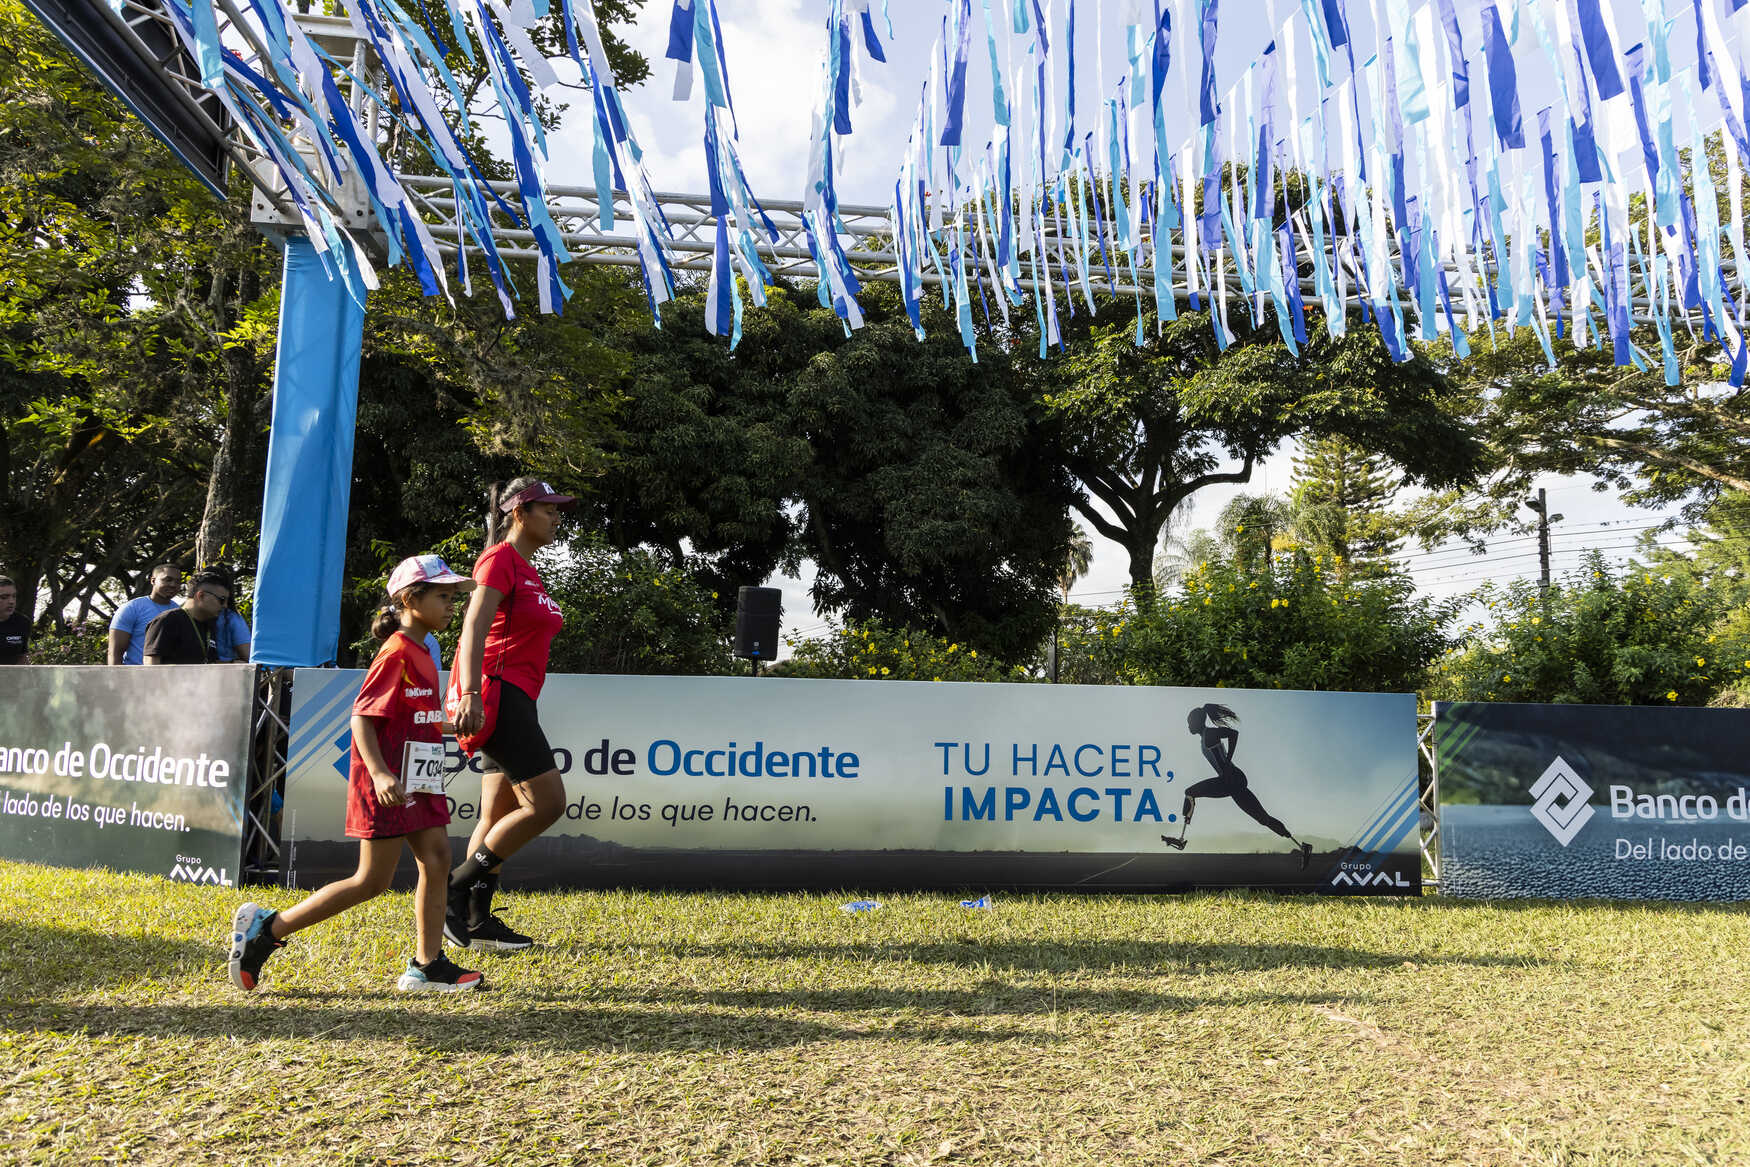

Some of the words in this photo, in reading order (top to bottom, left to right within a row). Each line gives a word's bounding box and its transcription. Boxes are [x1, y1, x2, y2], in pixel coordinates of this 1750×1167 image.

[0, 747, 49, 774] anco
[54, 742, 84, 777] de
[89, 743, 230, 788] Occidente
[584, 739, 636, 775] de
[648, 740, 860, 778] Occidente
[934, 742, 990, 775] TU
[1012, 743, 1175, 782] HACER,
[3, 791, 38, 816] lado
[41, 794, 62, 818] de
[65, 796, 90, 821] los
[94, 806, 126, 829] que
[130, 801, 191, 832] hacen.
[566, 796, 601, 821] de
[611, 796, 651, 821] los
[662, 802, 714, 827] que
[723, 797, 818, 822] hacen.
[944, 786, 1177, 822] IMPACTA.
[1610, 785, 1718, 820] Banco
[1726, 787, 1750, 820] d
[176, 854, 202, 865] Grupo
[1615, 838, 1652, 860] Del
[1661, 838, 1712, 860] lado
[1718, 838, 1747, 860] de
[169, 863, 232, 886] AVAL
[1331, 871, 1411, 887] AVAL
[1340, 862, 1372, 873] Grupo
